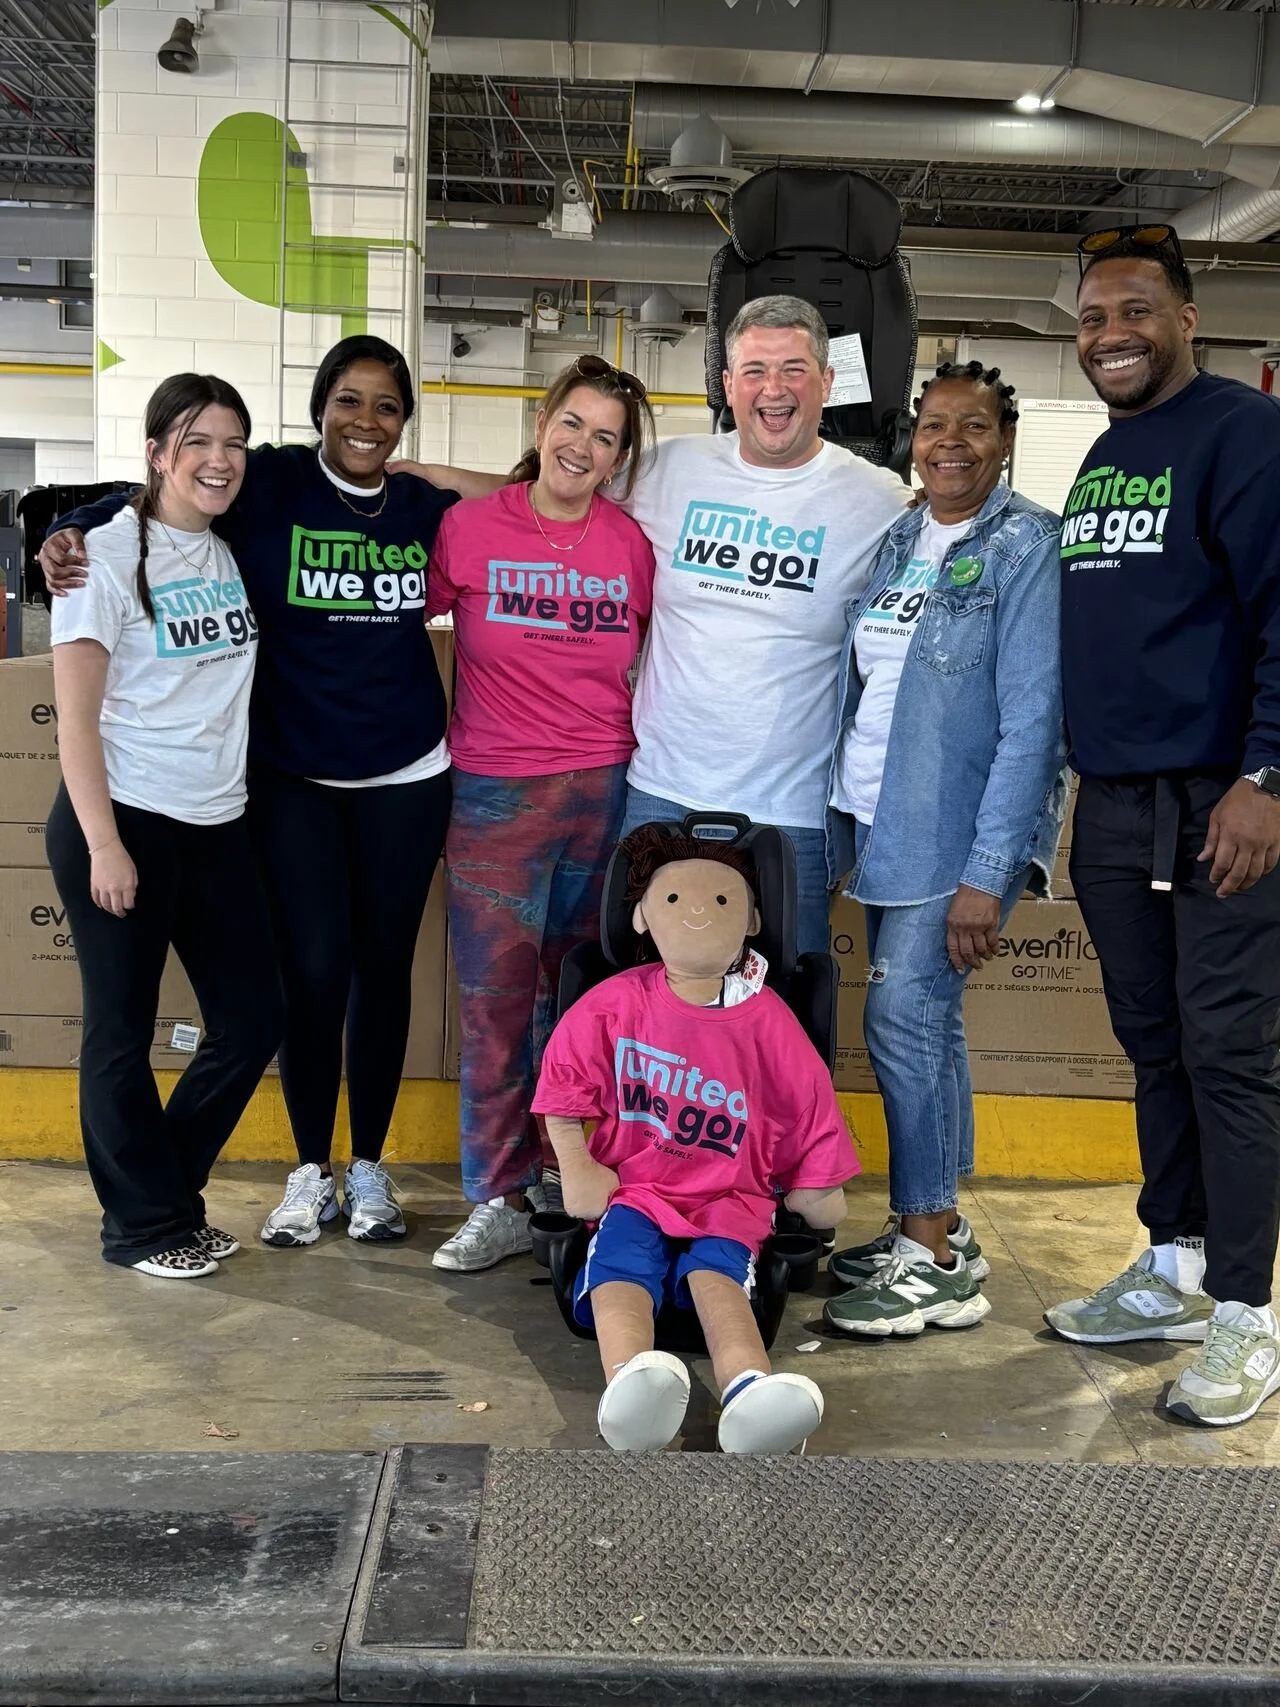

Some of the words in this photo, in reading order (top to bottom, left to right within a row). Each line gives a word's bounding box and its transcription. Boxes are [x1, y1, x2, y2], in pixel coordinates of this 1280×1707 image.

[1069, 466, 1172, 515] united
[692, 509, 827, 557] united
[1061, 512, 1099, 548] we
[1102, 508, 1170, 554] go!
[304, 533, 429, 572] united
[684, 538, 740, 570] we
[748, 550, 820, 588] go!
[300, 569, 364, 600] we
[374, 569, 427, 612] go!
[501, 562, 629, 602] united
[715, 584, 740, 596] THERE
[740, 589, 772, 600] SAFELY.
[167, 617, 221, 649] we
[345, 615, 370, 623] THERE
[502, 593, 560, 620] we
[569, 600, 630, 634] go!
[863, 624, 873, 632] GET
[873, 626, 889, 635] THERE
[890, 628, 912, 637] SAFELY.
[523, 631, 538, 640] GET
[540, 633, 565, 642] THERE
[565, 636, 596, 645] SAFELY.
[980, 1053, 1009, 1062] CONTIENT
[1010, 1054, 1014, 1062] 2
[1073, 1057, 1098, 1065] DOSSIER
[626, 1051, 748, 1121] united
[622, 1083, 669, 1122] we
[674, 1105, 747, 1153] go!
[663, 1143, 694, 1161] SAFELY.
[1175, 1239, 1202, 1250] NESS
